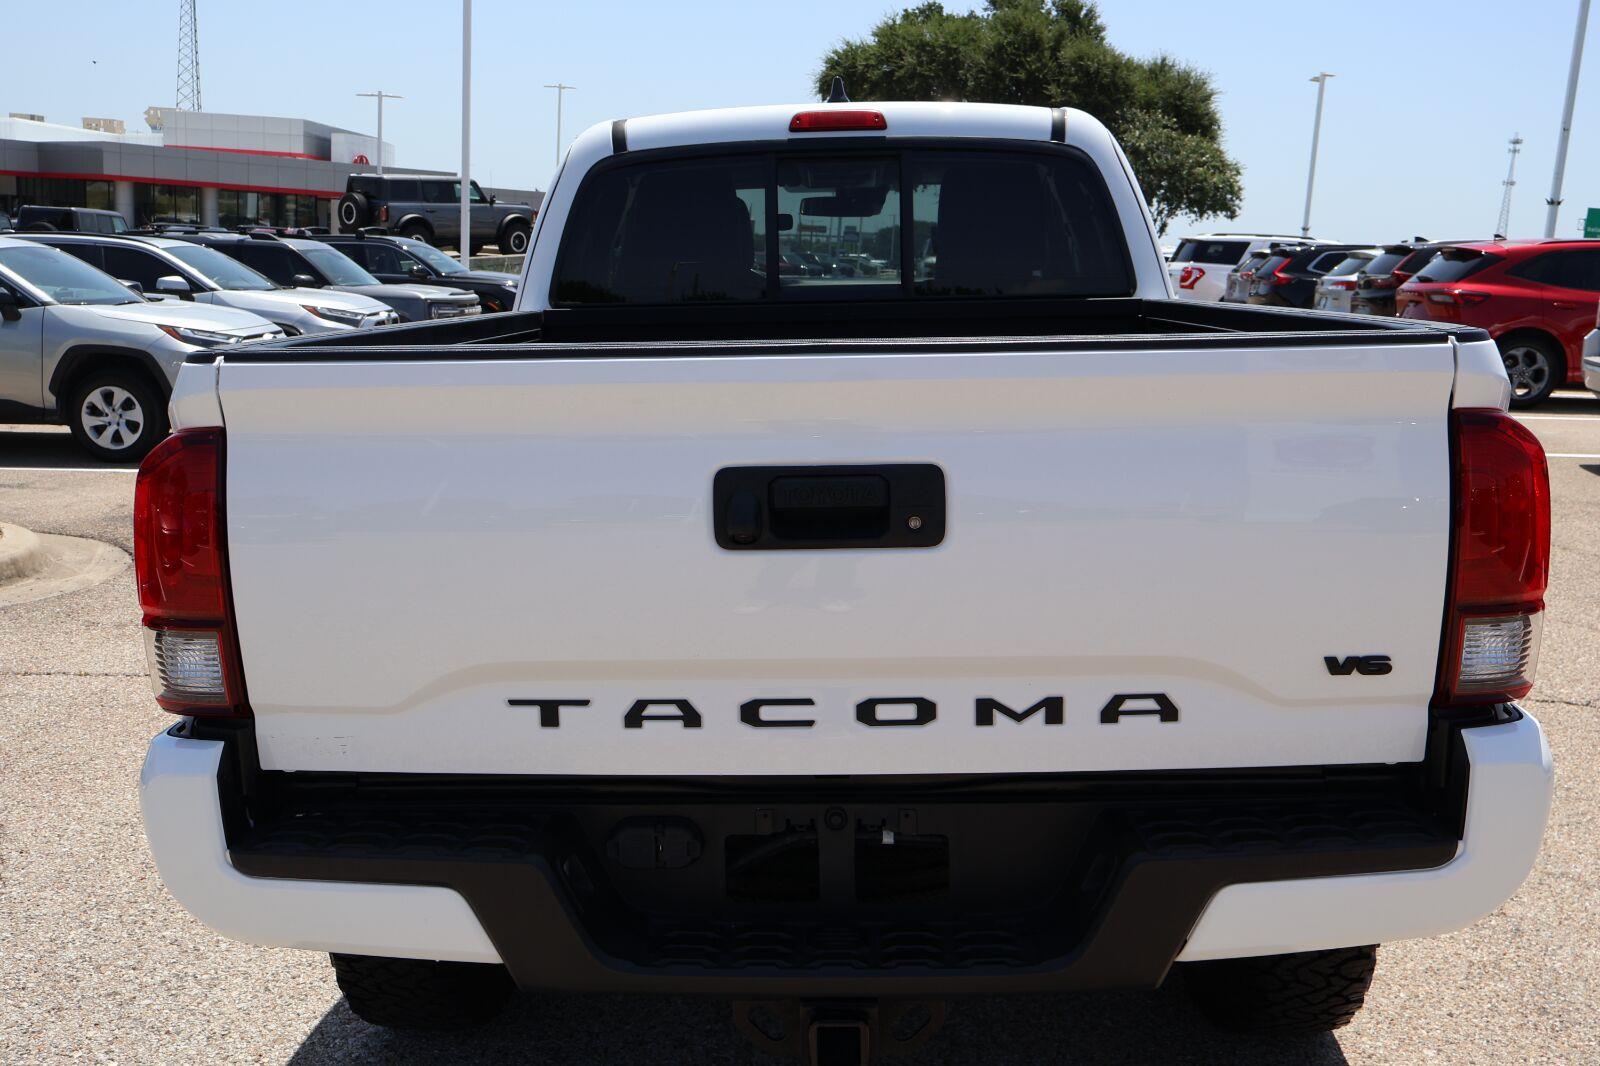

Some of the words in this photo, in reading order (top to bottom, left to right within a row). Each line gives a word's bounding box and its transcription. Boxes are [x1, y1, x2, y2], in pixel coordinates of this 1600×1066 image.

[784, 485, 880, 505] TOYOTA
[1324, 655, 1392, 675] V6
[508, 693, 1179, 729] TACOMA
